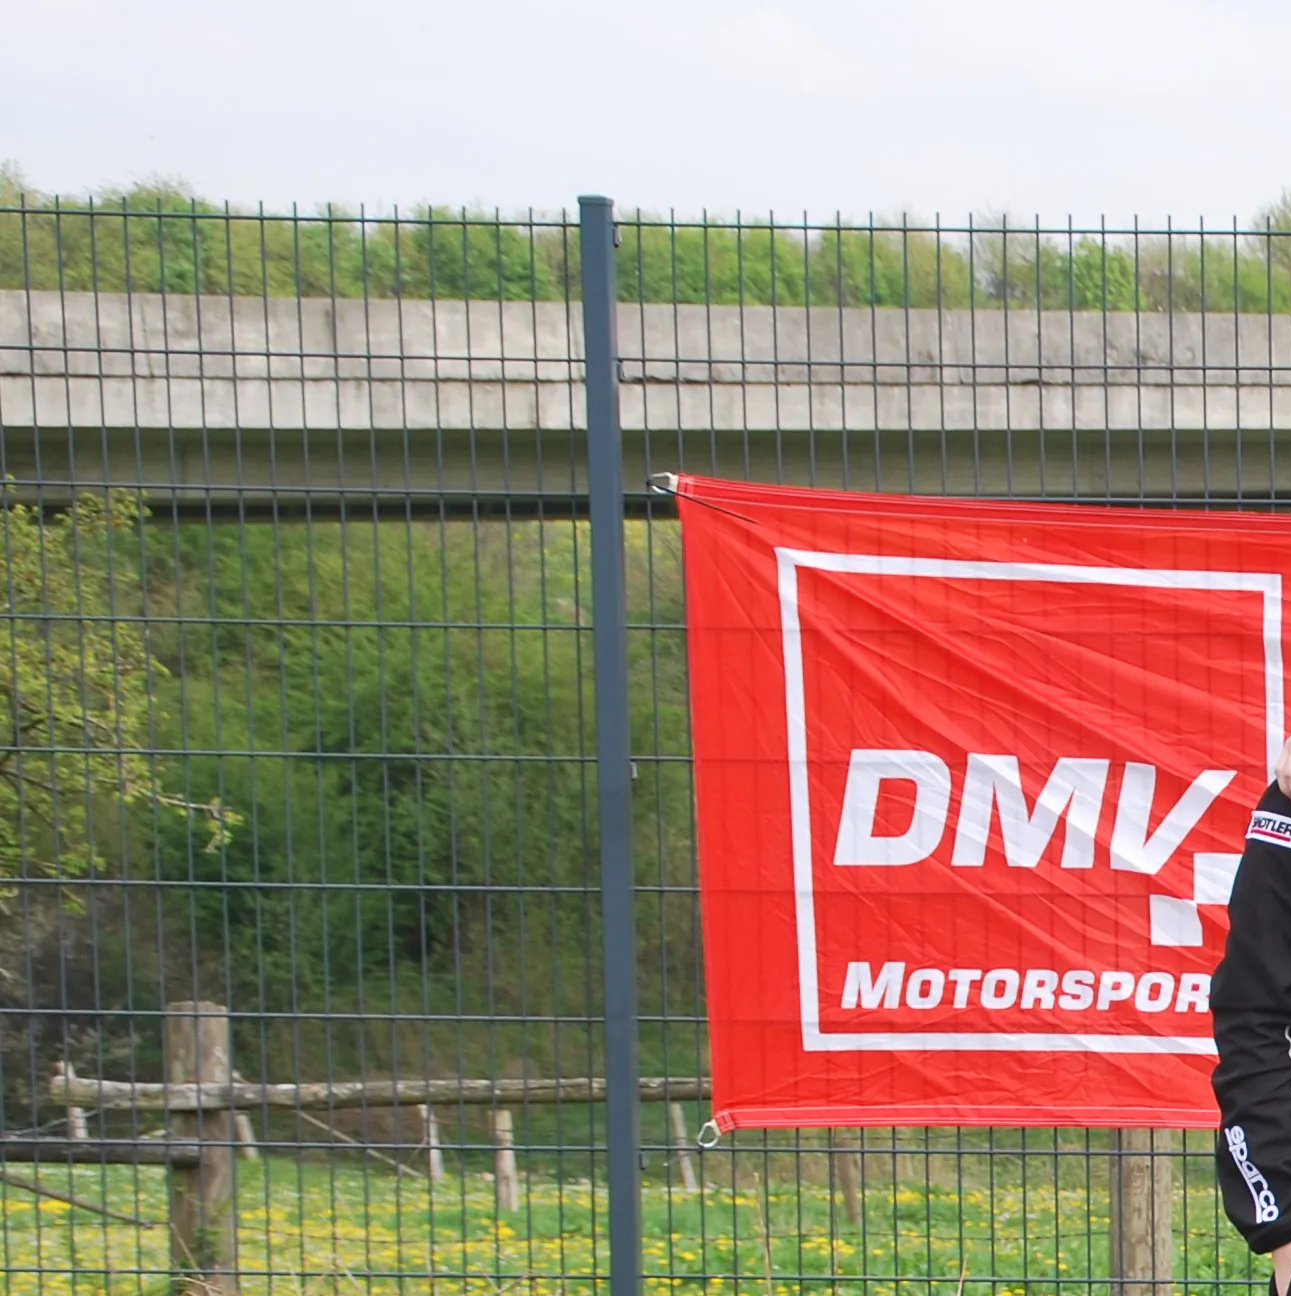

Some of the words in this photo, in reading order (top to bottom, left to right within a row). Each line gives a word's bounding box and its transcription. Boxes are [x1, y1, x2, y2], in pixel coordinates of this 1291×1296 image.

[833, 748, 1238, 875] DMV
[840, 961, 1212, 1014] MOTORSPOR
[1224, 1125, 1279, 1225] sparco
